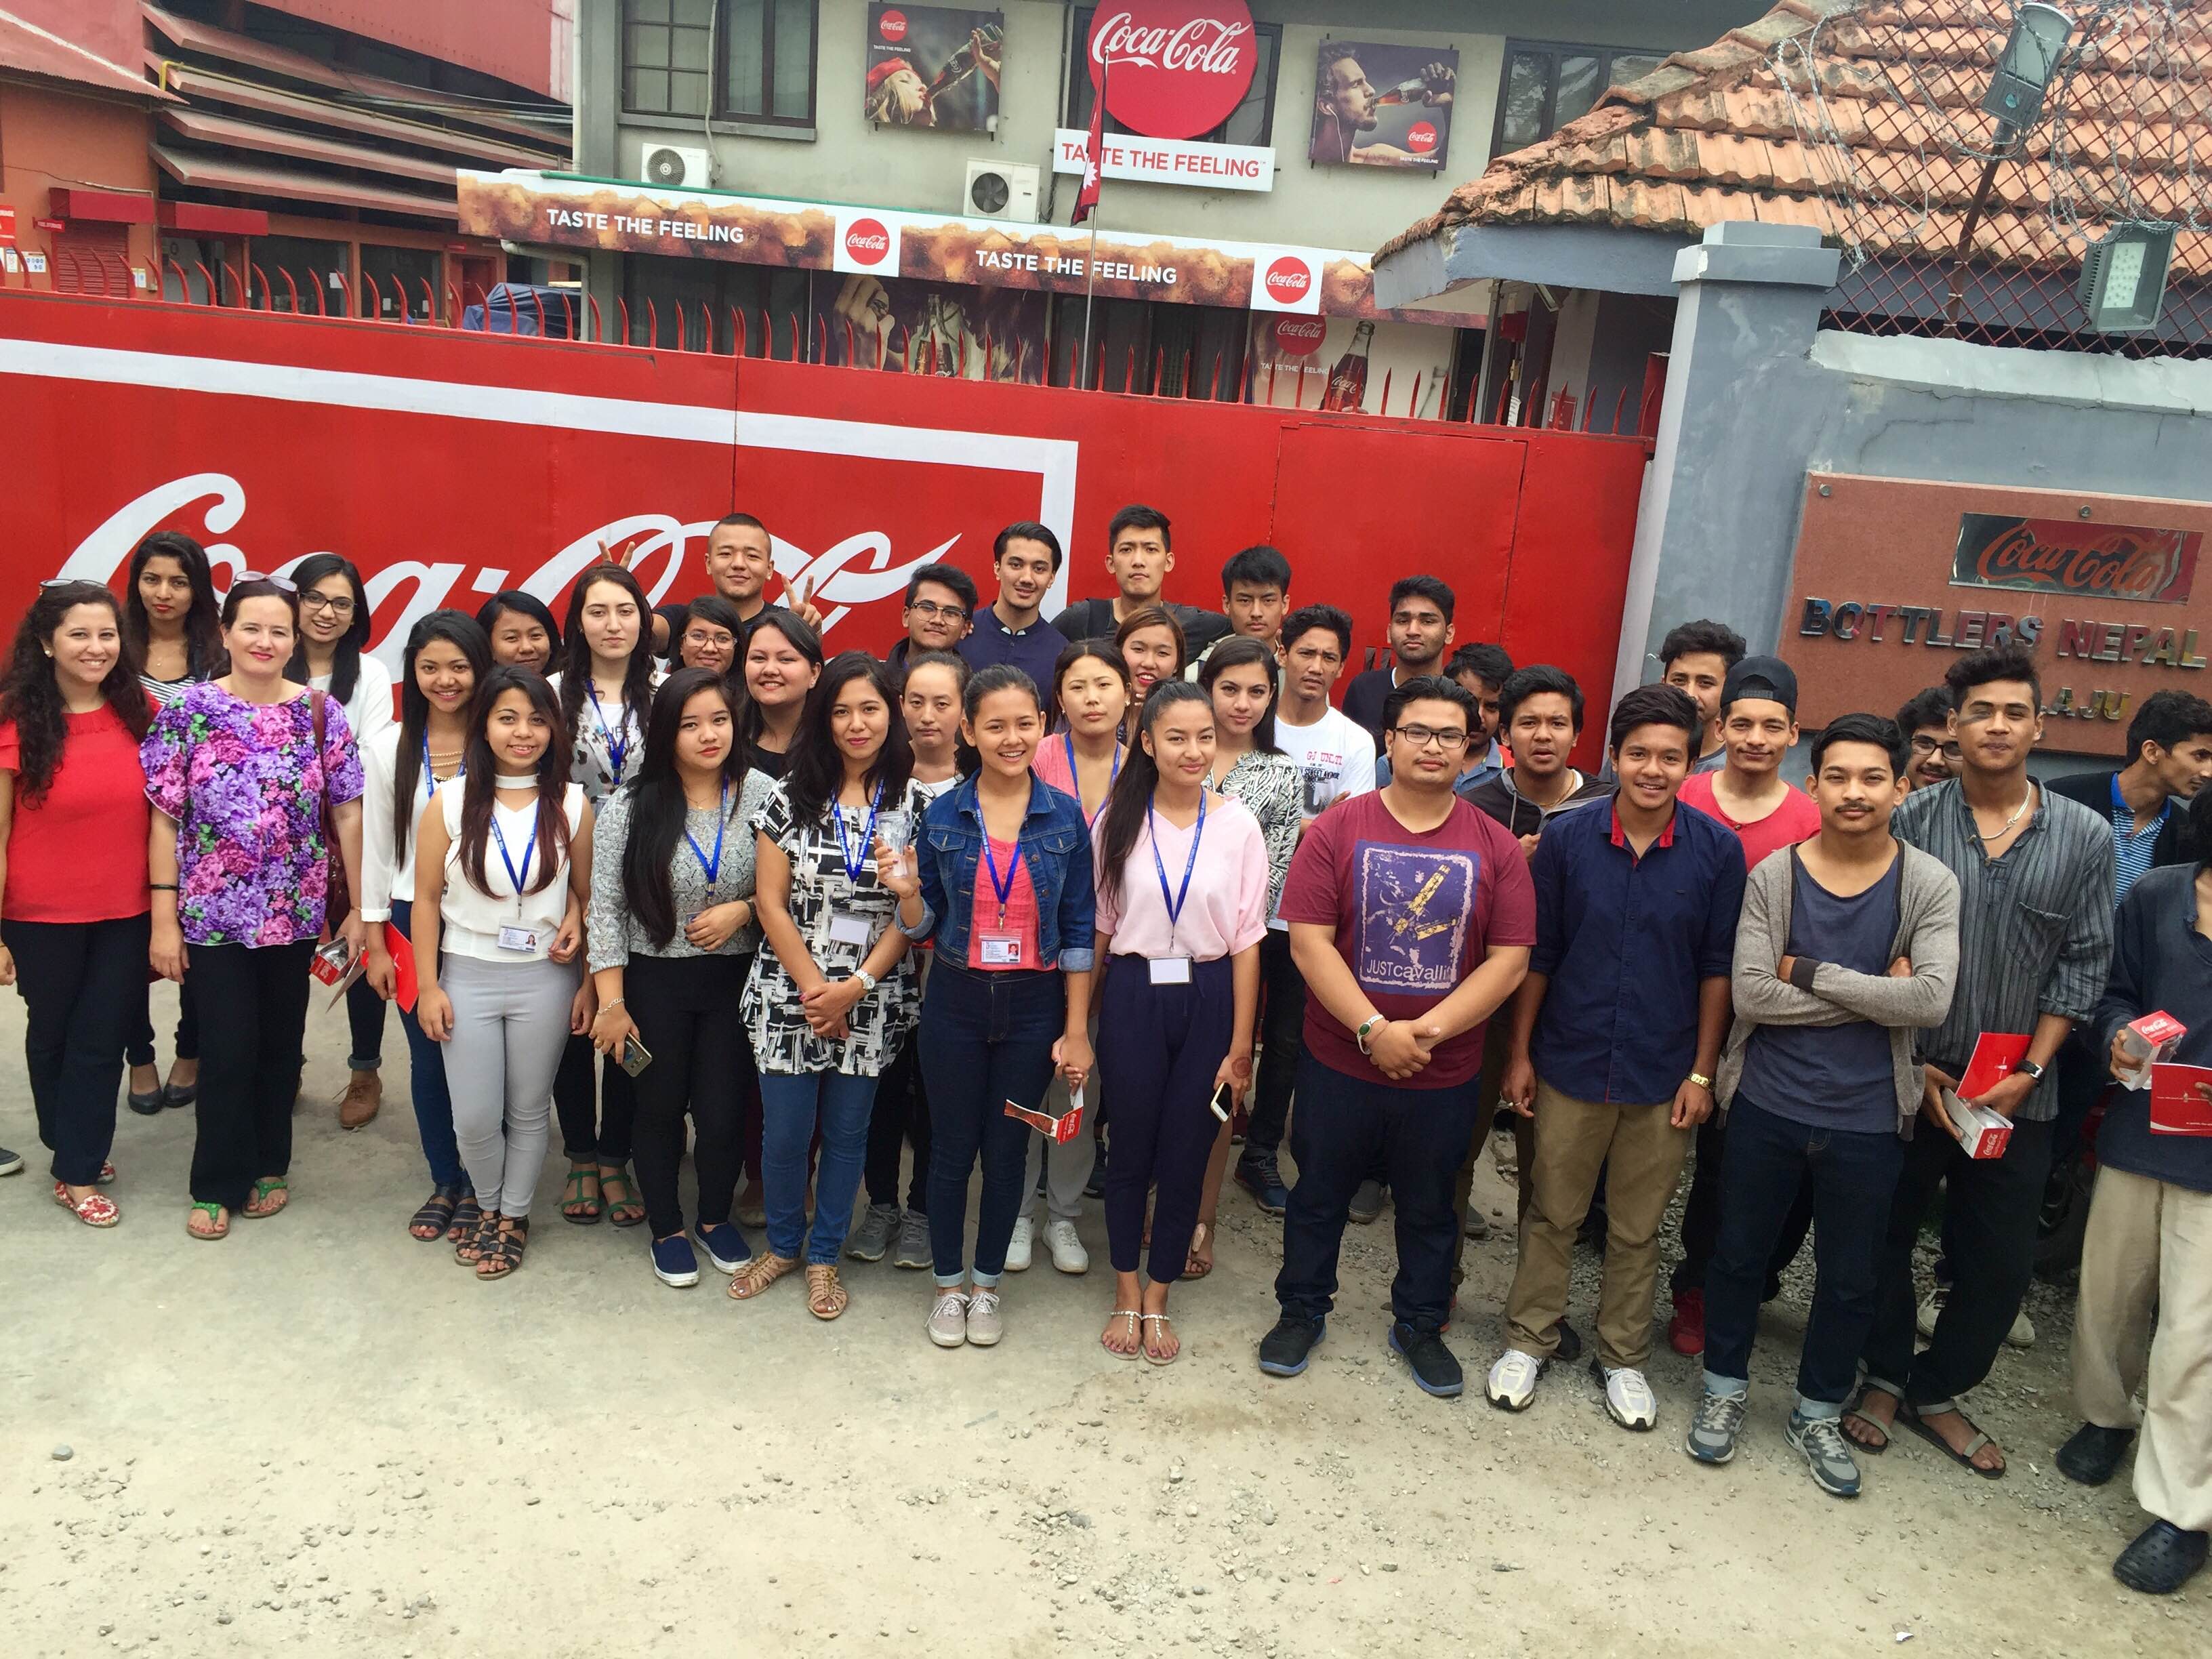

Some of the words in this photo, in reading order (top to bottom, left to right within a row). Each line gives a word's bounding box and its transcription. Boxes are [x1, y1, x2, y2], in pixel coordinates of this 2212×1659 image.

[1092, 12, 1252, 74] Coca-Cola
[1061, 142, 1124, 166] TATE
[1129, 150, 1169, 171] THE
[546, 209, 608, 230] TASTE
[614, 215, 653, 235] THE
[659, 220, 744, 243] FEELING
[846, 233, 888, 250] Coca-Cola
[975, 249, 1038, 271] TASTE
[1044, 256, 1084, 276] THE
[1092, 261, 1177, 284] FEELING
[1267, 271, 1309, 288] Coca-Cola
[1277, 319, 1323, 338] Coca-Cola
[1261, 363, 1283, 371] TATE
[1303, 366, 1330, 374] EELING
[1799, 596, 2045, 647] BOTTLERS
[2057, 618, 2208, 668] NEPAL
